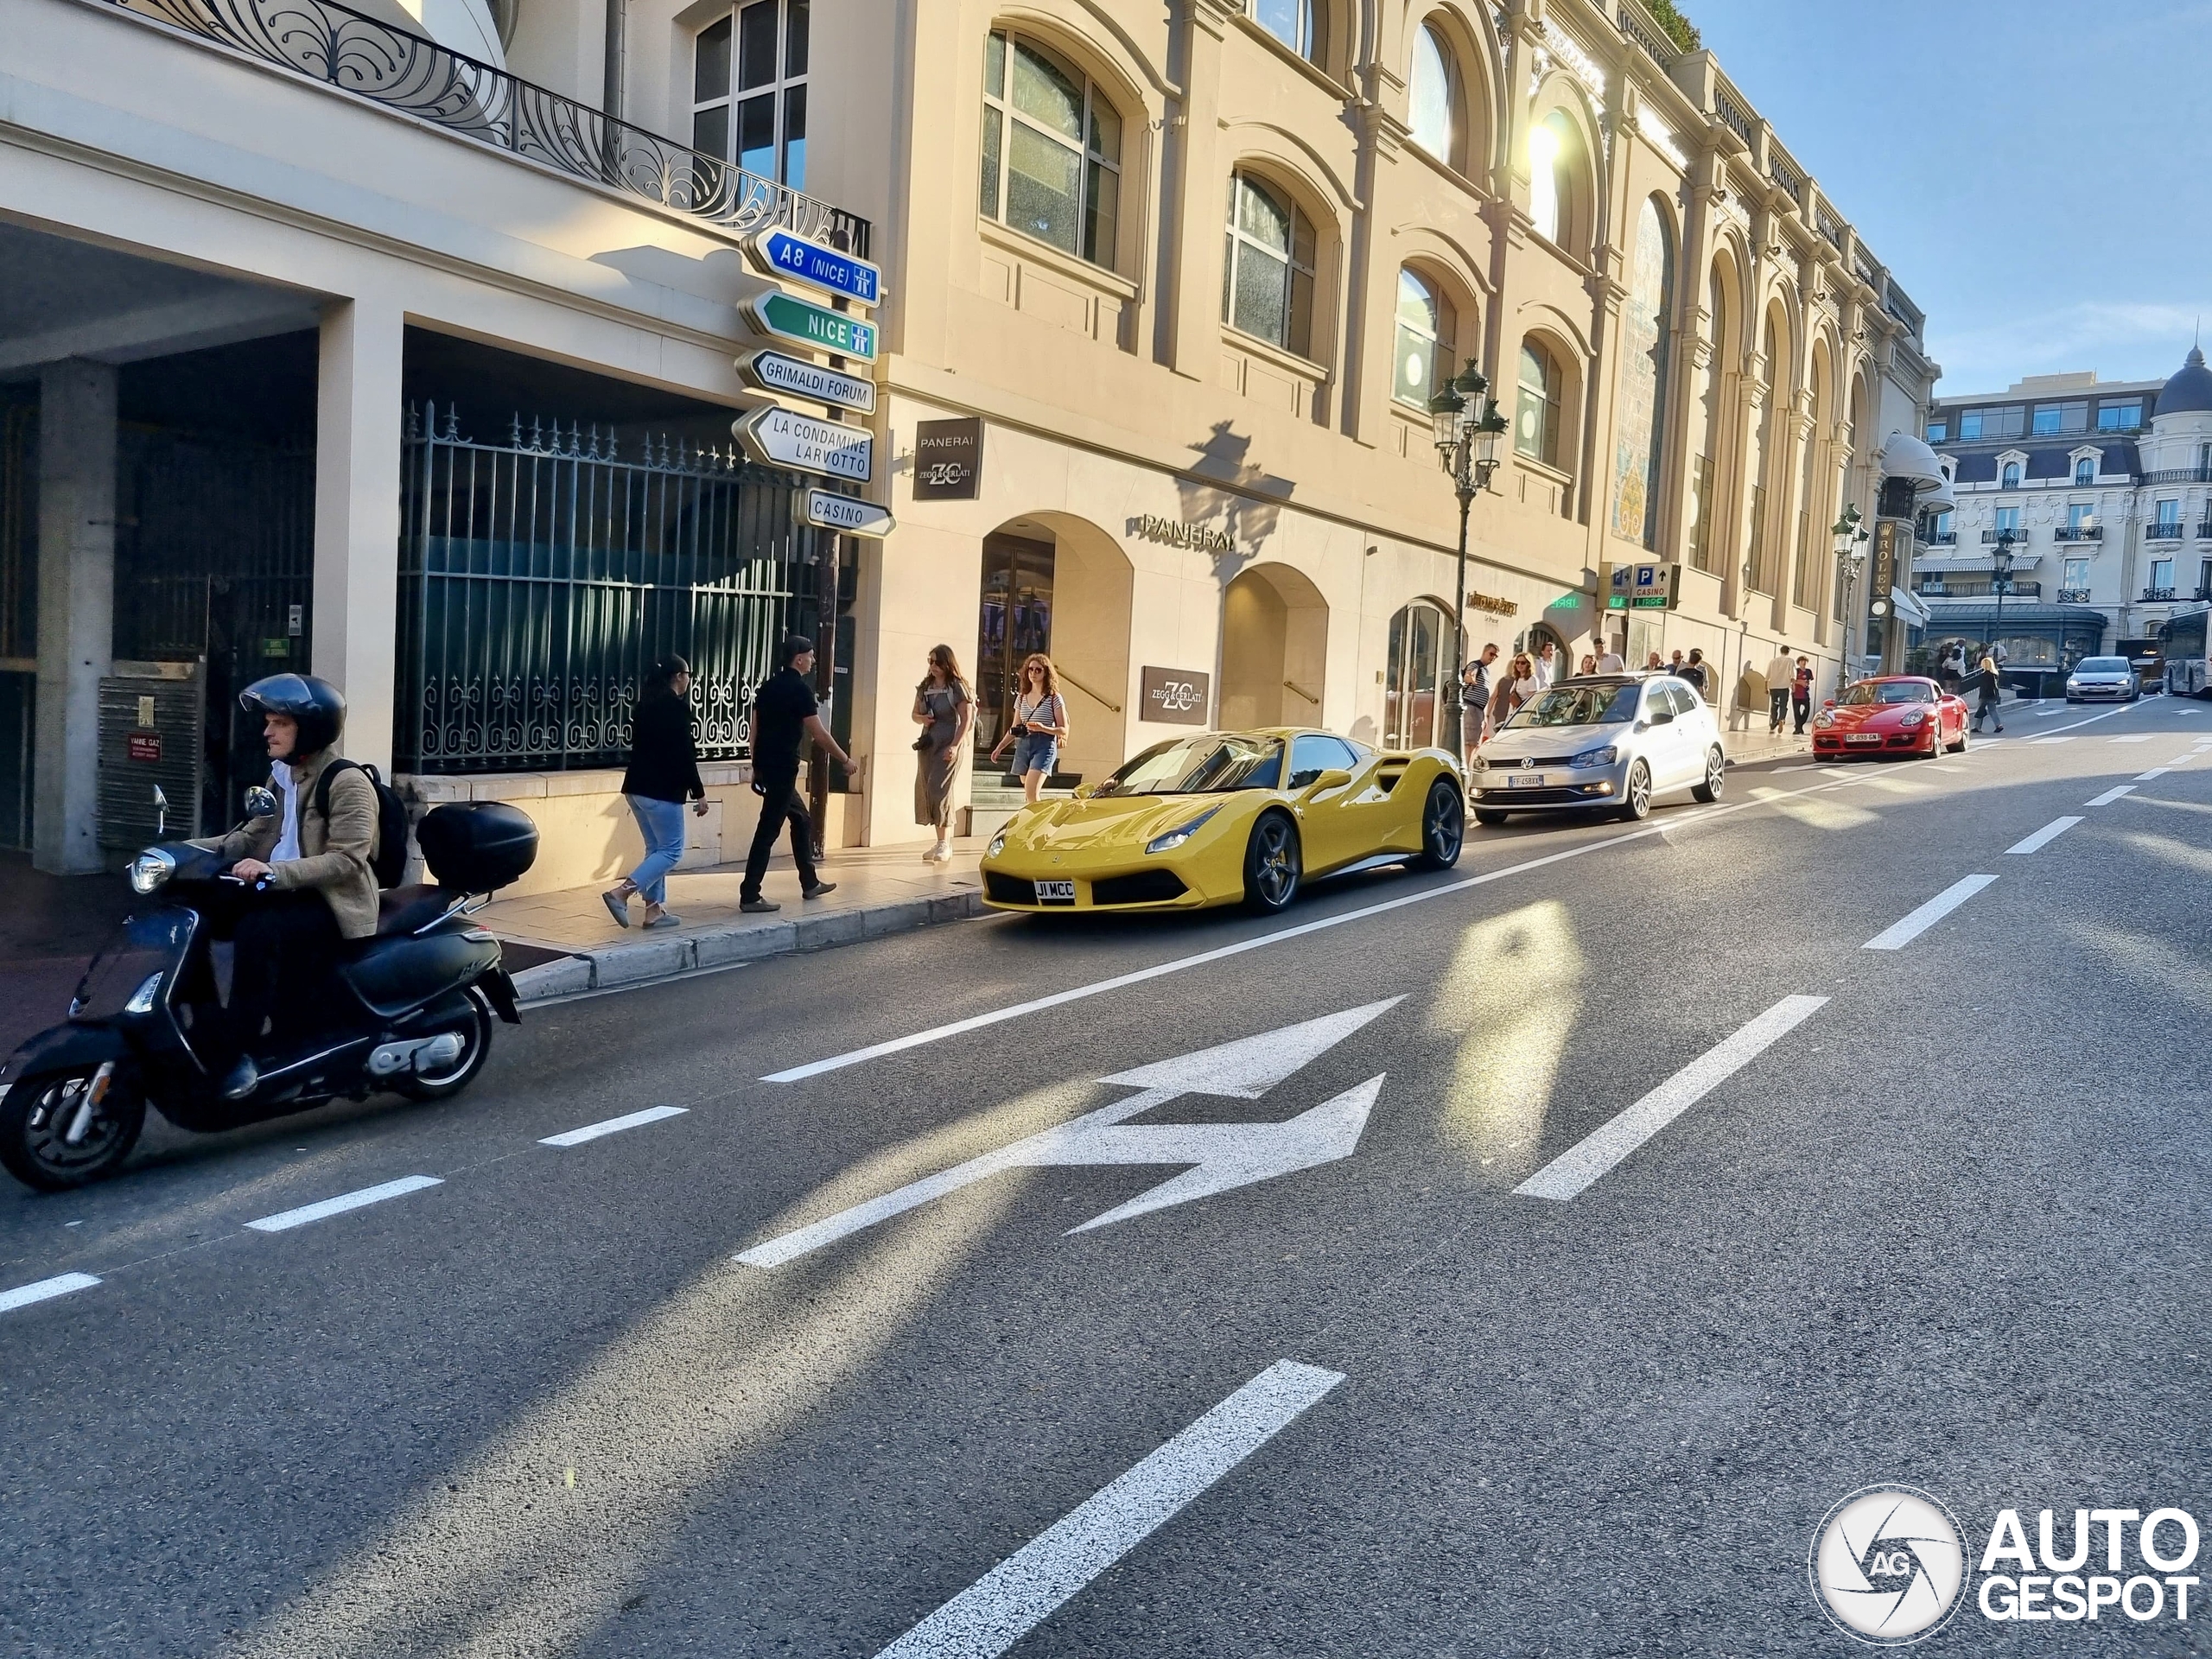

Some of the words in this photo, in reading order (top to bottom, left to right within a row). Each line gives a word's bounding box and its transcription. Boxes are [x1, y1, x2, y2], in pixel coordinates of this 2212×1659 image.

[779, 243, 804, 268] A8
[811, 257, 849, 286] (NICE)
[808, 314, 847, 345] NICE
[766, 361, 823, 391] GRIMALDI
[827, 379, 868, 404] FORUM
[773, 417, 789, 435] LA
[794, 423, 866, 454] CONDAMINE
[920, 436, 973, 448] PANERAI
[796, 443, 865, 473] LARVOTTO
[815, 501, 863, 524] CASINO
[1143, 513, 1234, 551] PANERAI
[1641, 570, 1649, 582] P
[1877, 540, 1888, 594] ROLEX
[1636, 598, 1663, 607] LIBRE
[1049, 883, 1073, 896] MCC
